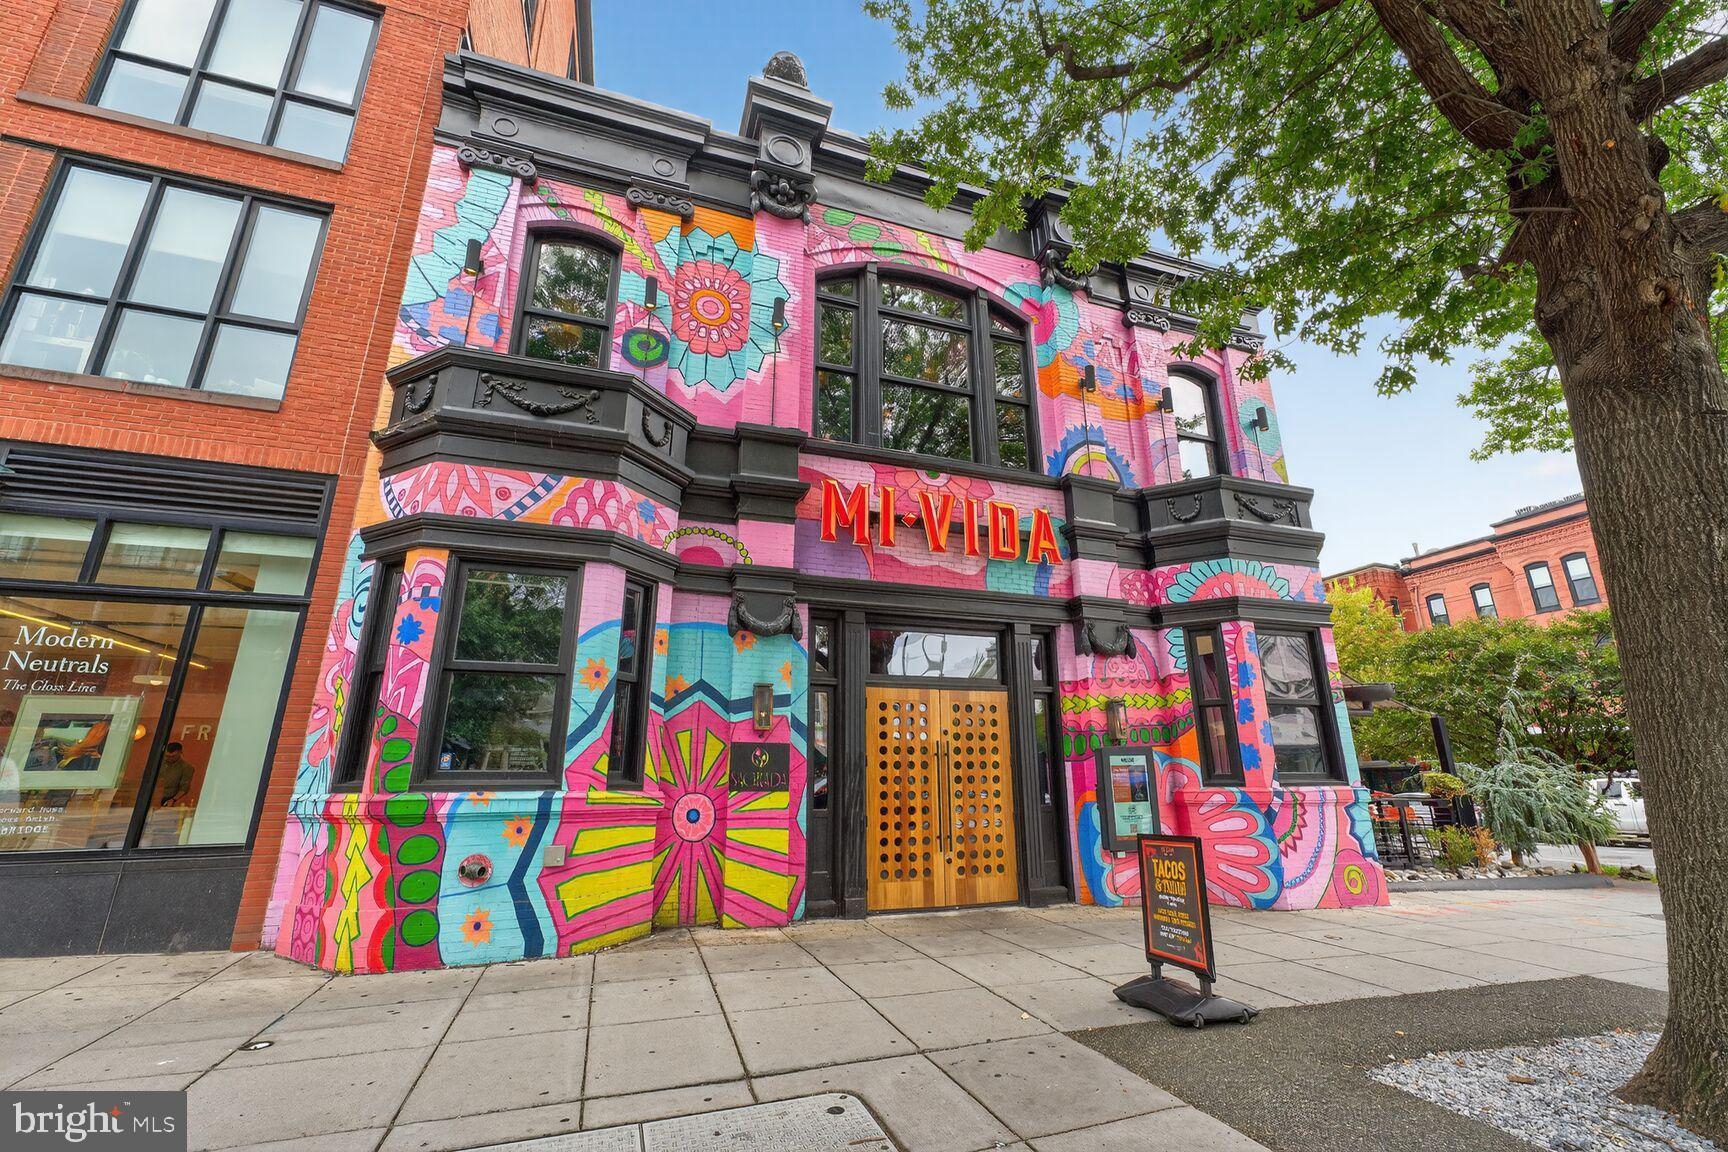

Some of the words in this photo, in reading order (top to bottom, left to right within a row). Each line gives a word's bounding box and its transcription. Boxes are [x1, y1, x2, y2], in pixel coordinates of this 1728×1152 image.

[820, 478, 896, 547] MI
[917, 490, 1064, 566] VIDA
[14, 625, 114, 650] Modern
[1, 650, 110, 675] Neutrals
[3, 679, 28, 691] The
[31, 679, 65, 692] Gloss
[67, 680, 97, 693] Line
[1151, 857, 1187, 881] TACOS
